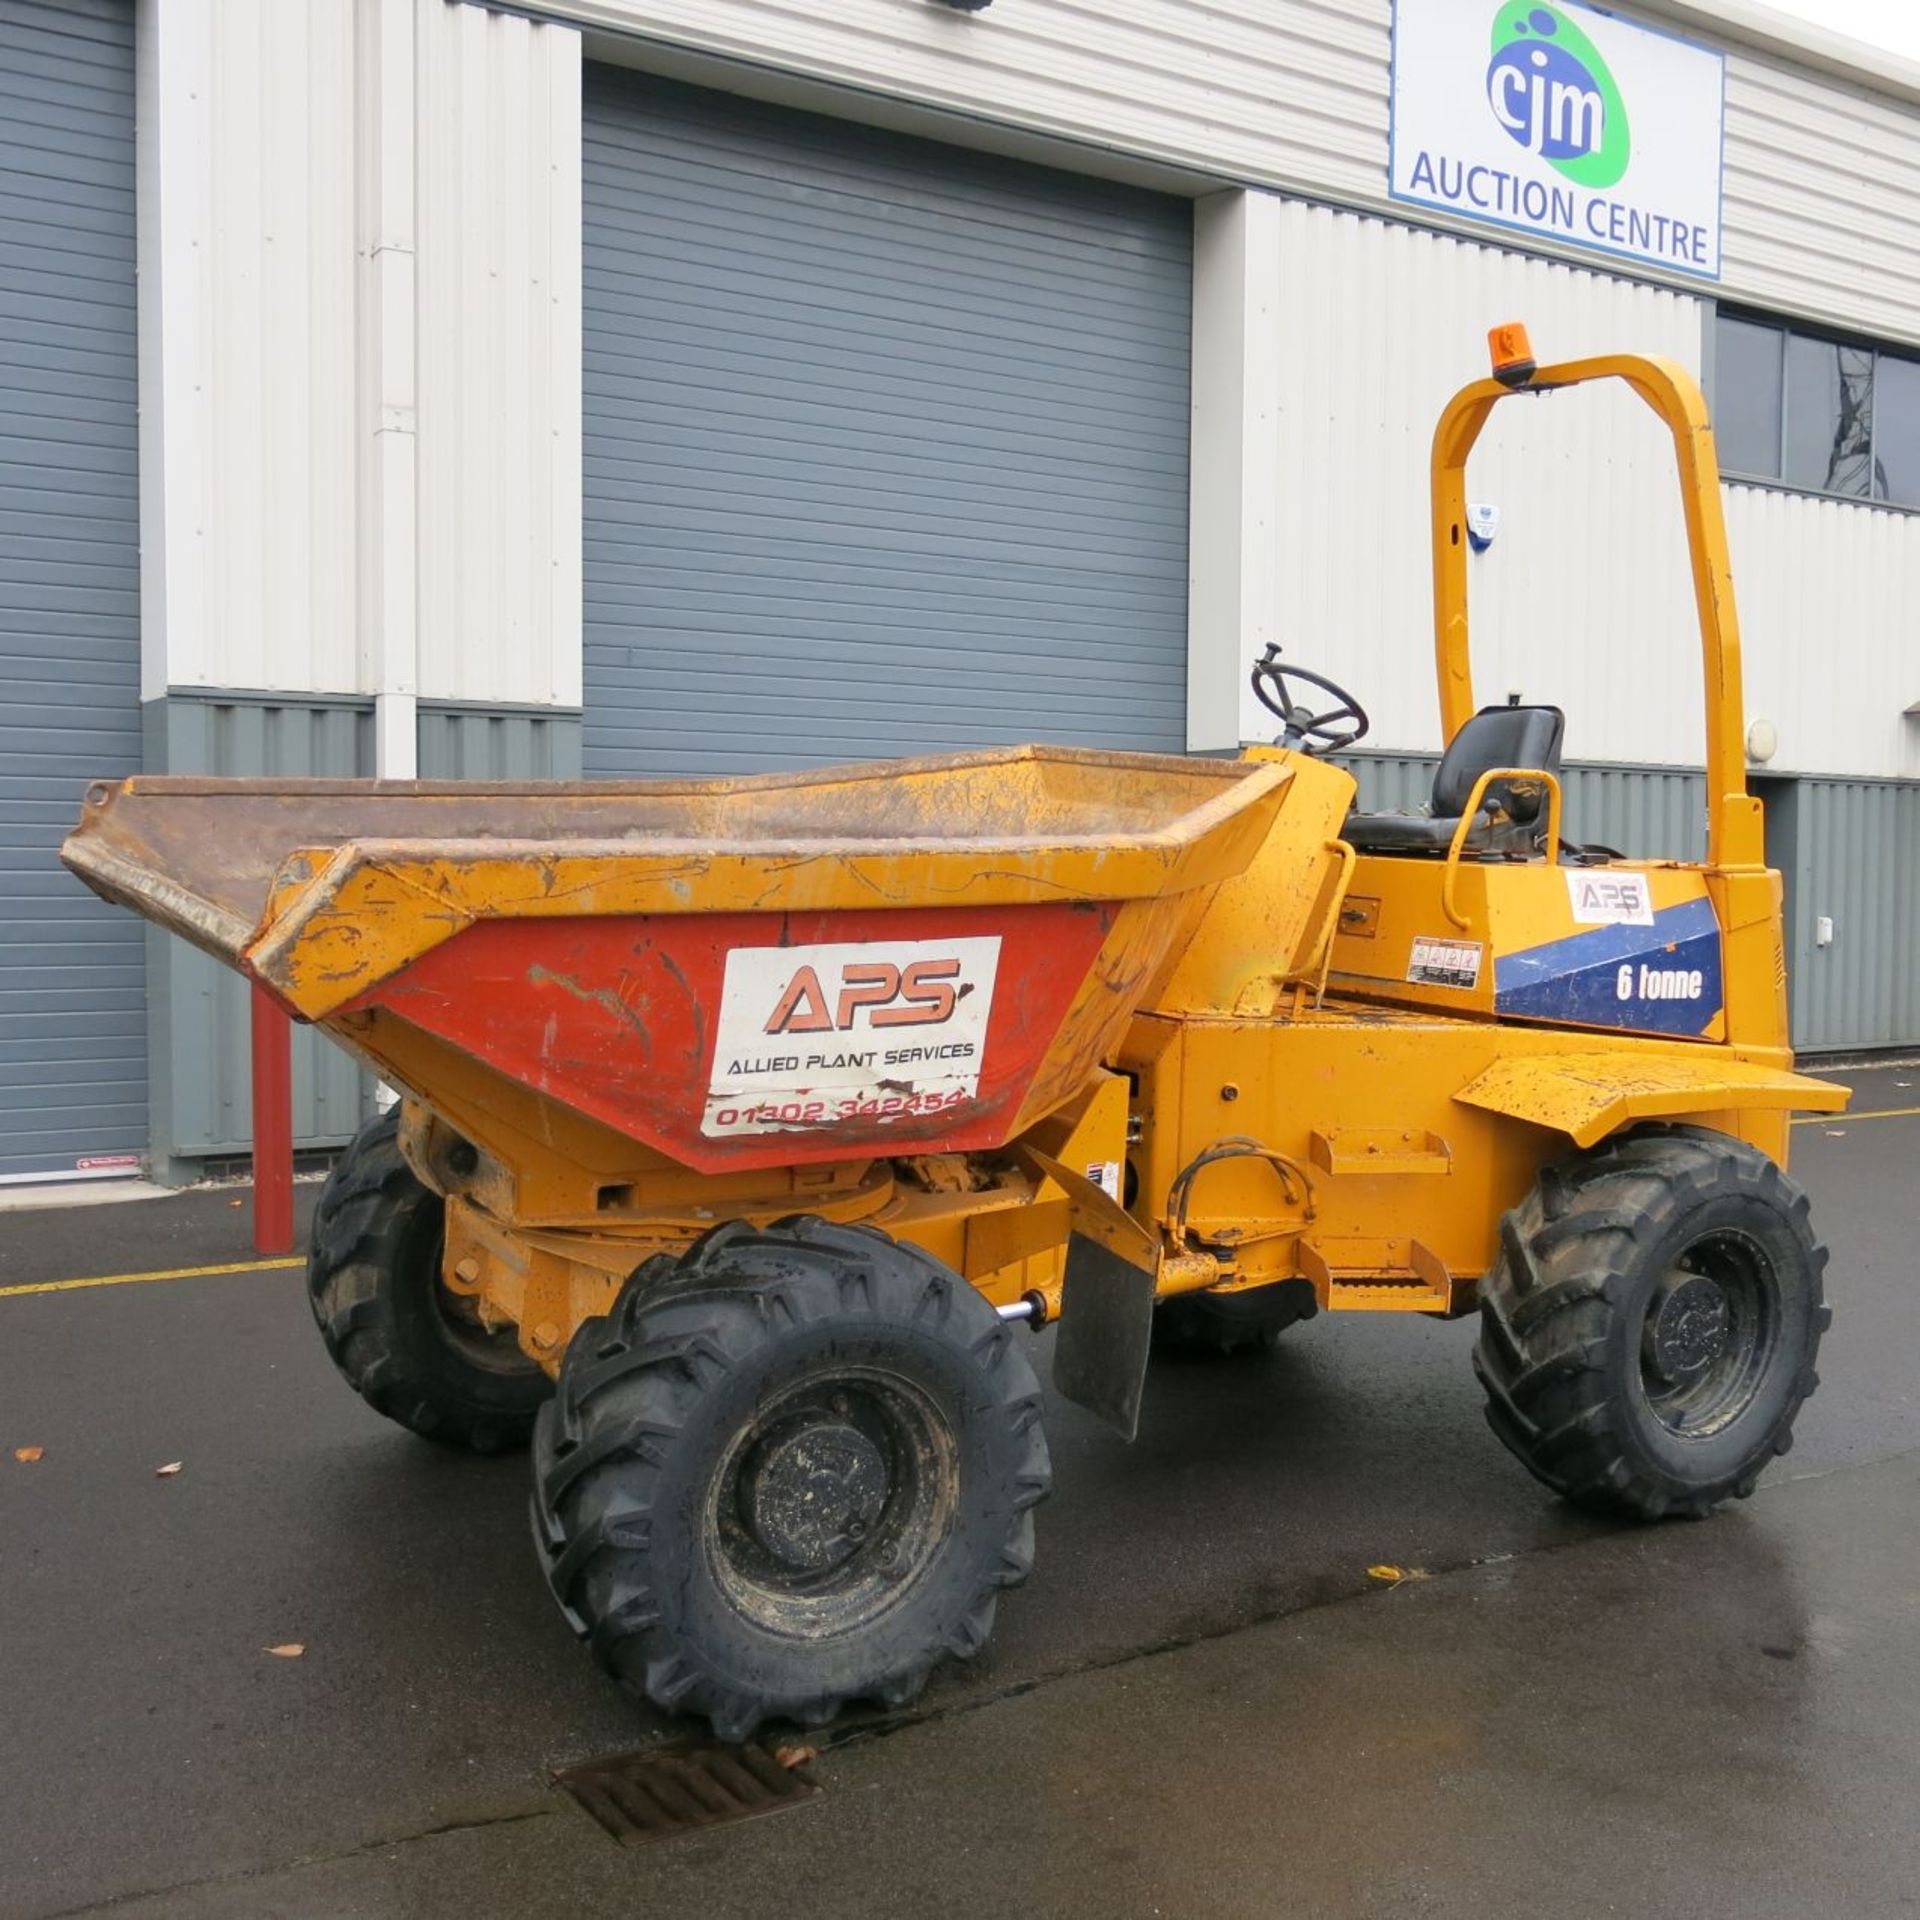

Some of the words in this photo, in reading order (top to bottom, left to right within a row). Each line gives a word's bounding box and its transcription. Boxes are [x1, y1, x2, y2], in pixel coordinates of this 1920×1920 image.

[1491, 50, 1602, 154] cjm
[1410, 151, 1574, 229] AUCTION
[1586, 198, 1707, 264] CENTRE
[1582, 884, 1640, 909] APS
[763, 958, 961, 1034] APS
[1616, 964, 1633, 1000] 6
[1638, 964, 1702, 999] tonne
[727, 1055, 799, 1075] ALLIED
[806, 1052, 877, 1069] PLANT
[884, 1043, 974, 1065] SERVICES
[716, 1101, 825, 1126] 01302
[837, 1089, 965, 1119] 342454
